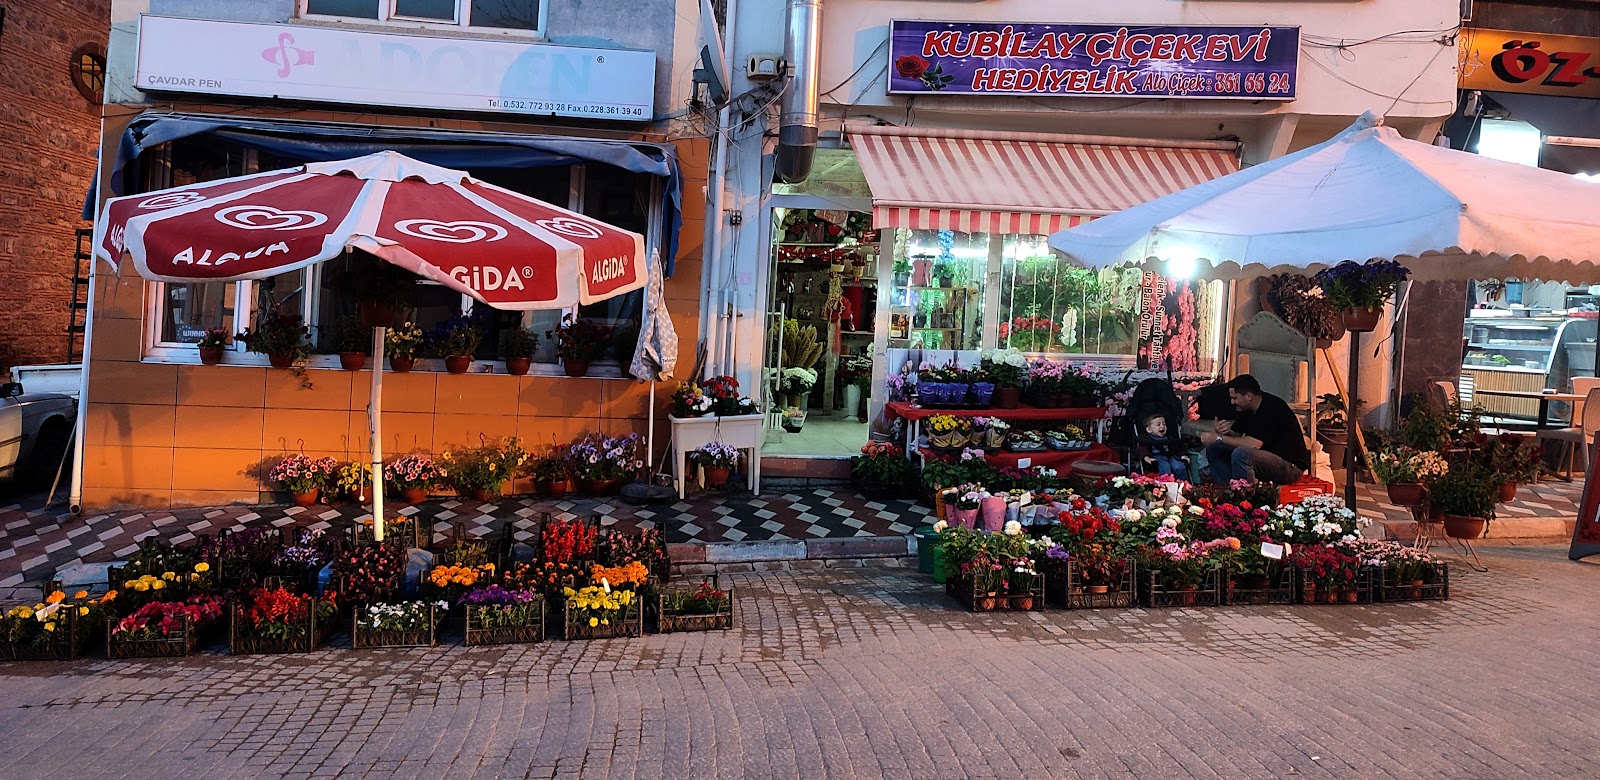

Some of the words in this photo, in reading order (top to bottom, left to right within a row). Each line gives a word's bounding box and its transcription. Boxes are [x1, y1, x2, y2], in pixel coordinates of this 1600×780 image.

[922, 25, 1086, 59] KUBİLAY
[148, 75, 196, 87] ÇAVDAR
[199, 79, 222, 88] PEN
[971, 64, 1140, 94] HEDİYELİK
[1142, 72, 1166, 92] Alo
[1214, 72, 1241, 93] 361
[1244, 72, 1266, 93] 66
[1268, 73, 1291, 93] 24
[488, 99, 501, 108] Tel.
[529, 101, 543, 110] 772
[544, 102, 554, 111] 93
[556, 103, 565, 112] 28
[621, 107, 631, 115] 39
[632, 108, 642, 116] 40
[1142, 287, 1153, 311] Balon
[1156, 275, 1167, 300] elenk
